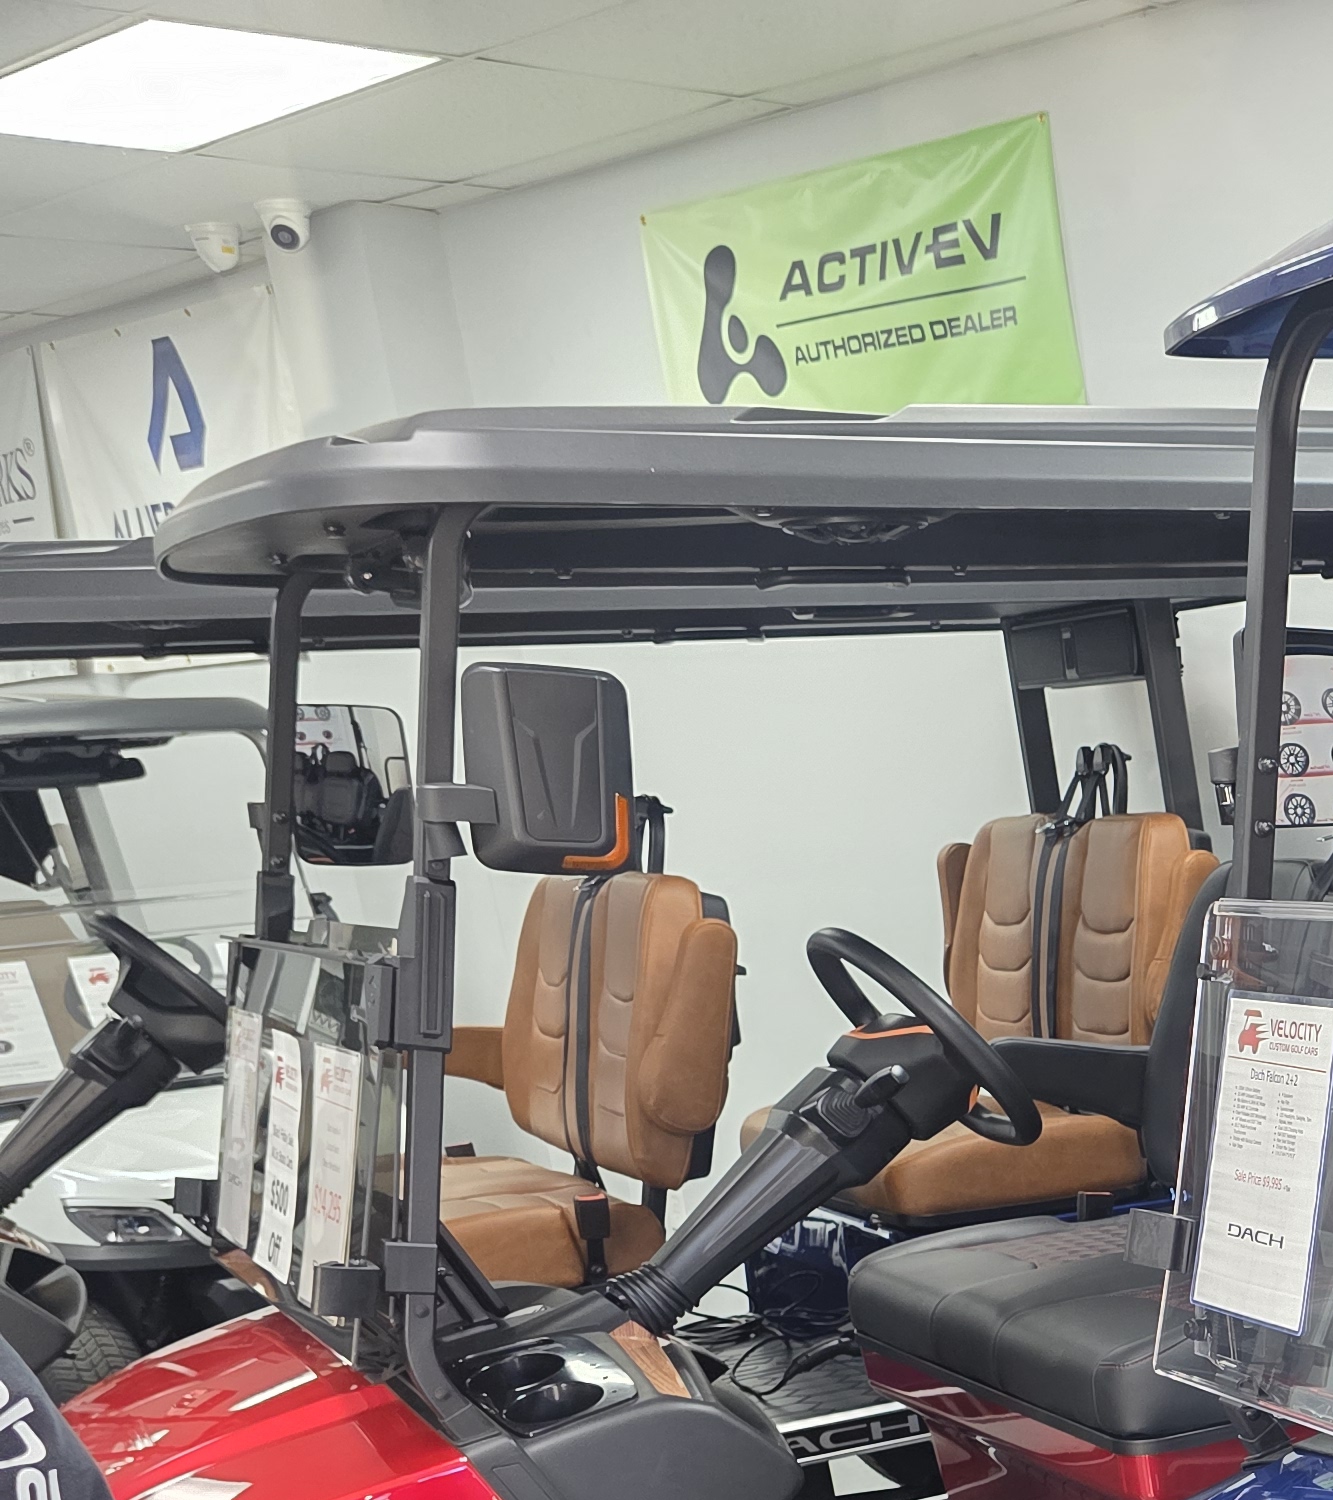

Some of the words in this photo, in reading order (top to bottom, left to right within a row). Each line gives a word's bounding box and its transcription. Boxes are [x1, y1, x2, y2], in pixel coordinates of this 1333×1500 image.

[795, 323, 926, 367] AUTHORIZED
[928, 305, 1018, 341] DEALER
[1270, 1018, 1323, 1042] VELOCITY
[1269, 1041, 1290, 1053] CUSTOM
[1290, 1044, 1304, 1054] GOLF
[1304, 1046, 1318, 1057] CARS
[1250, 1067, 1265, 1080] Dach
[1266, 1070, 1284, 1084] Falcon
[1285, 1073, 1299, 1087] 2+2
[1234, 1169, 1246, 1182] Sale
[1247, 1172, 1261, 1186] Price
[1227, 1222, 1285, 1250] DACH
[786, 1414, 921, 1453] ACH
